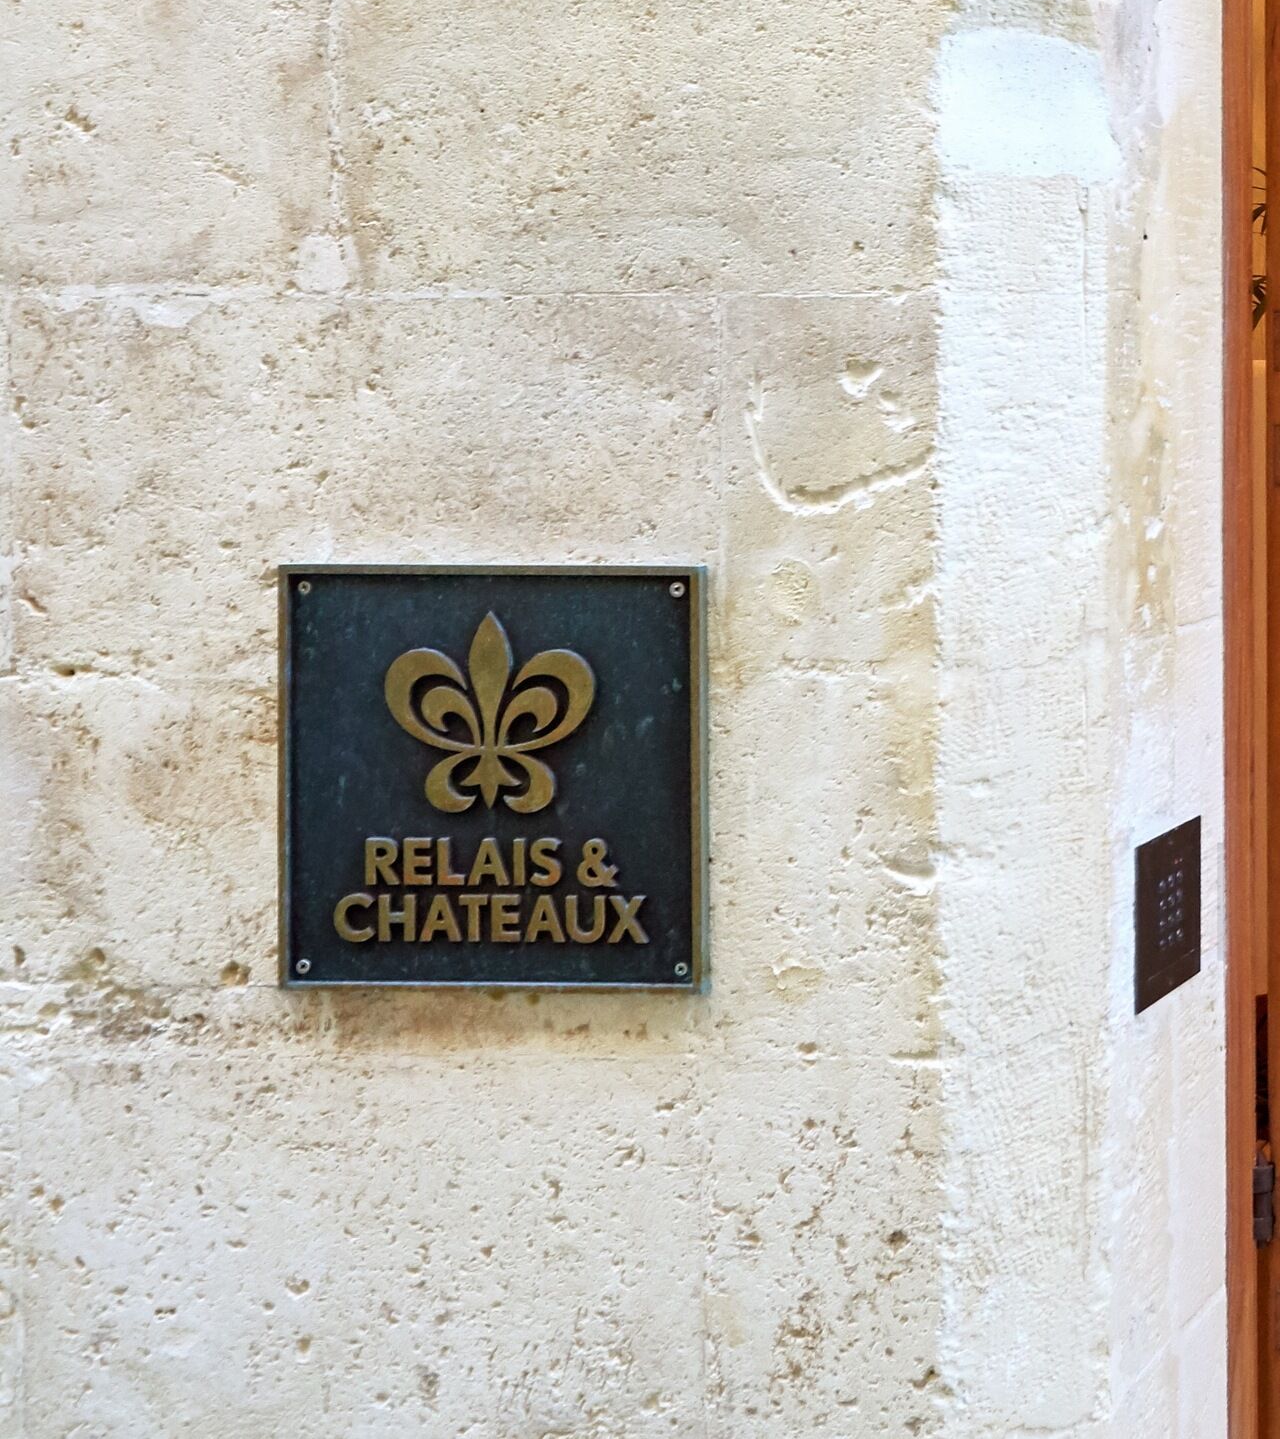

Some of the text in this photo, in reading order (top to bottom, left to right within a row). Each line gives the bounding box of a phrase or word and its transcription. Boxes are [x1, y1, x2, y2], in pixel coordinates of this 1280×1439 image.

[364, 837, 620, 888] RELAIS &
[333, 893, 650, 944] CHATEAUX
